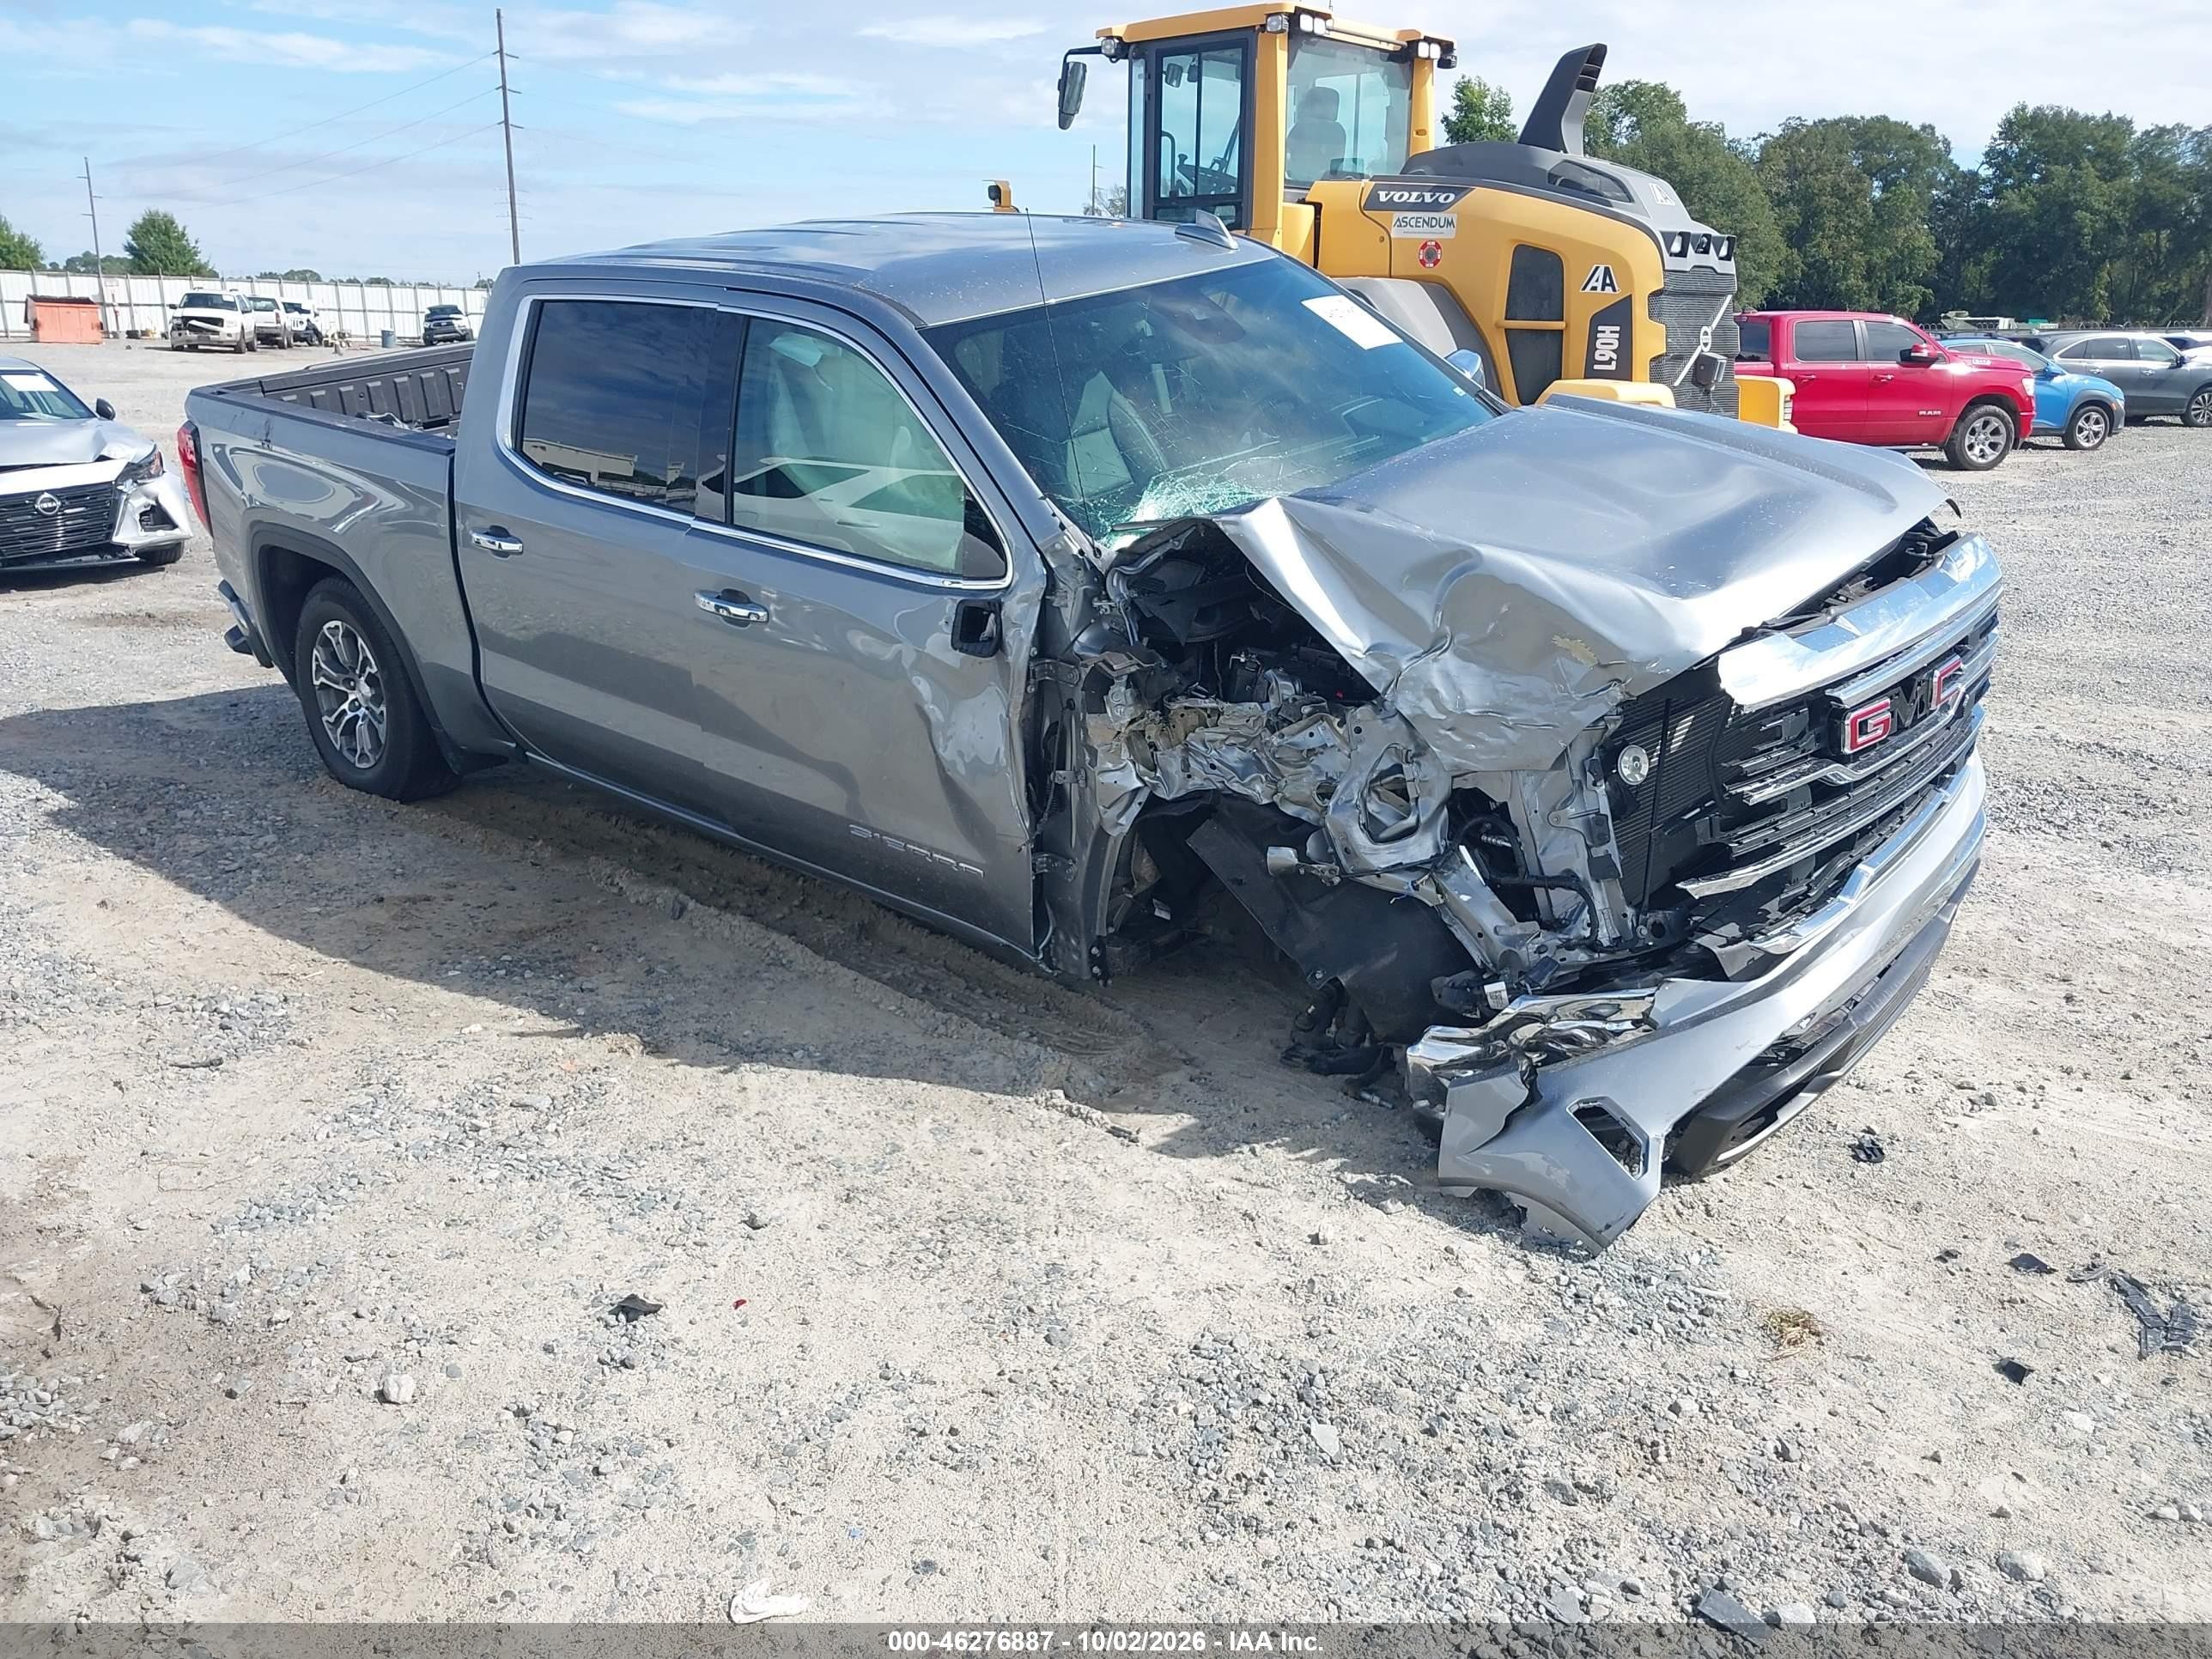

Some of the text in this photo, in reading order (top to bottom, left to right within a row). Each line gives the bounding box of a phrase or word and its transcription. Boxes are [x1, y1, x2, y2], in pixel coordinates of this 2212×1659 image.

[1376, 191, 1455, 204] VOLVO
[1393, 216, 1455, 228] ASCENDUM
[1593, 325, 1620, 371] L90H
[1841, 653, 1965, 754] GMC
